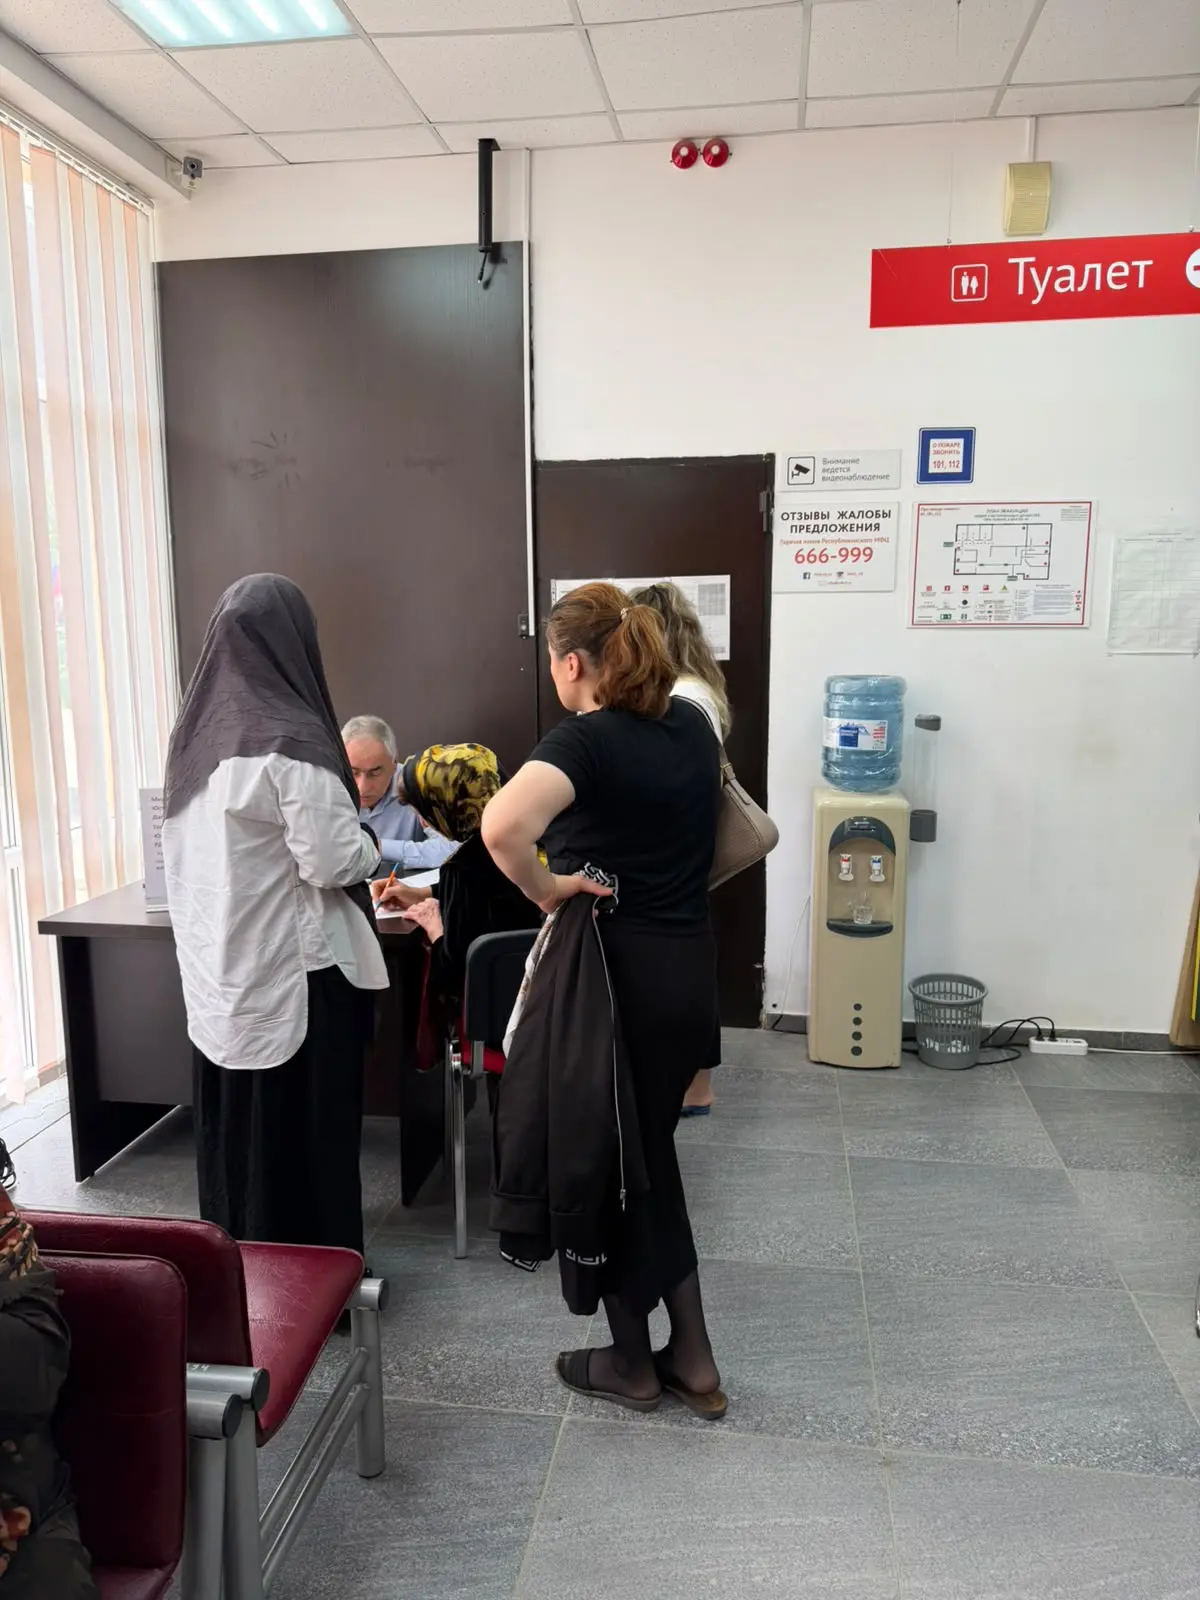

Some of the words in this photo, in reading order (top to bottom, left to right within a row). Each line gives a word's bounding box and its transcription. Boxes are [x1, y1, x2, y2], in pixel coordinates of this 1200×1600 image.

[1008, 257, 1153, 305] Туалет
[822, 457, 860, 465] Внимание
[948, 460, 960, 469] 112
[821, 466, 851, 474] ведется
[821, 473, 891, 482] видеонаблюдение
[780, 511, 830, 521] ОТЗЫВЫ
[836, 509, 892, 520] ЖАЛОБЫ
[790, 522, 881, 535] ПРЕДЛОЖЕНИЯ
[794, 546, 874, 565] 666-999
